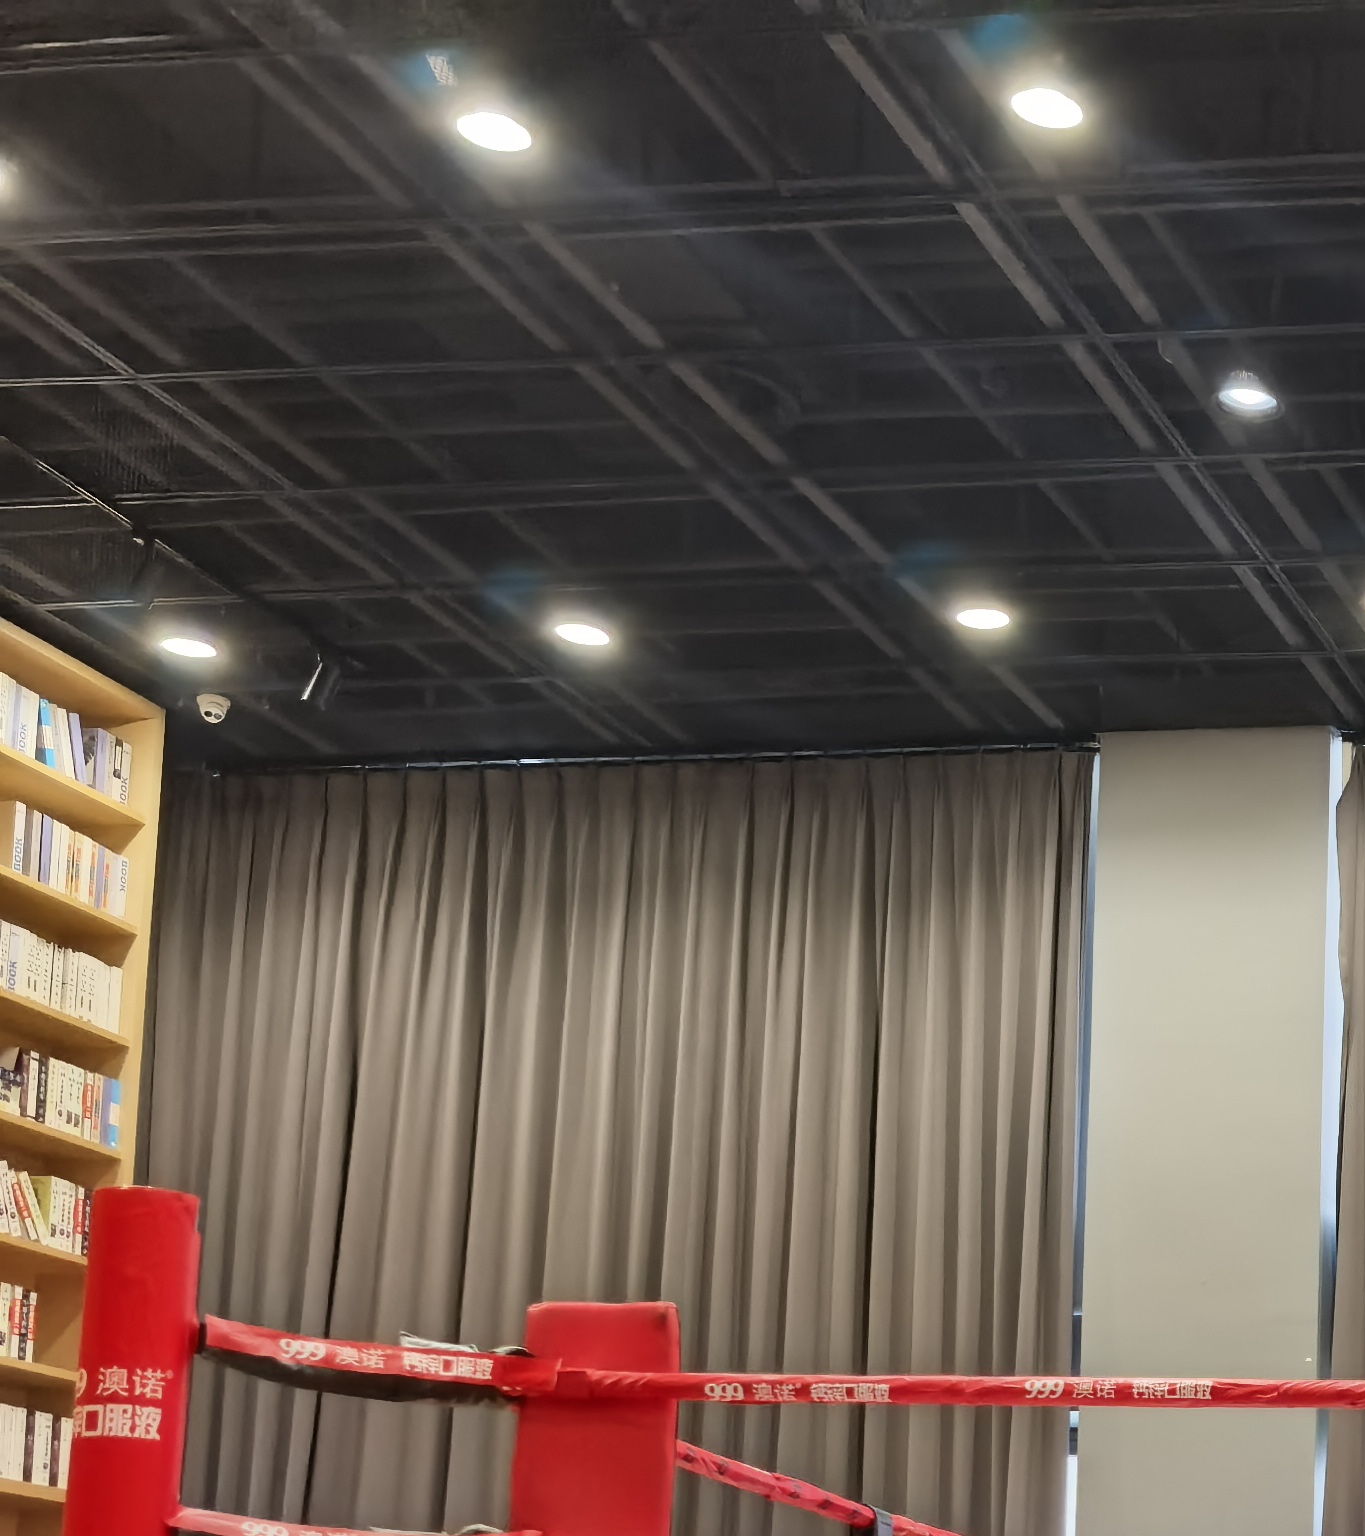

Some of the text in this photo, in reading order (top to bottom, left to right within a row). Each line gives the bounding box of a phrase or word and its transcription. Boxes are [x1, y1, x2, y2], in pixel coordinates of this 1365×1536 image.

[279, 1339, 326, 1361] 999
[335, 1348, 386, 1369] 澳诺
[97, 1369, 166, 1400] 澳诺
[705, 1383, 744, 1402] 999
[752, 1383, 796, 1402] 澳诺
[1025, 1380, 1064, 1399] 999
[1072, 1380, 1117, 1399] 澳诺
